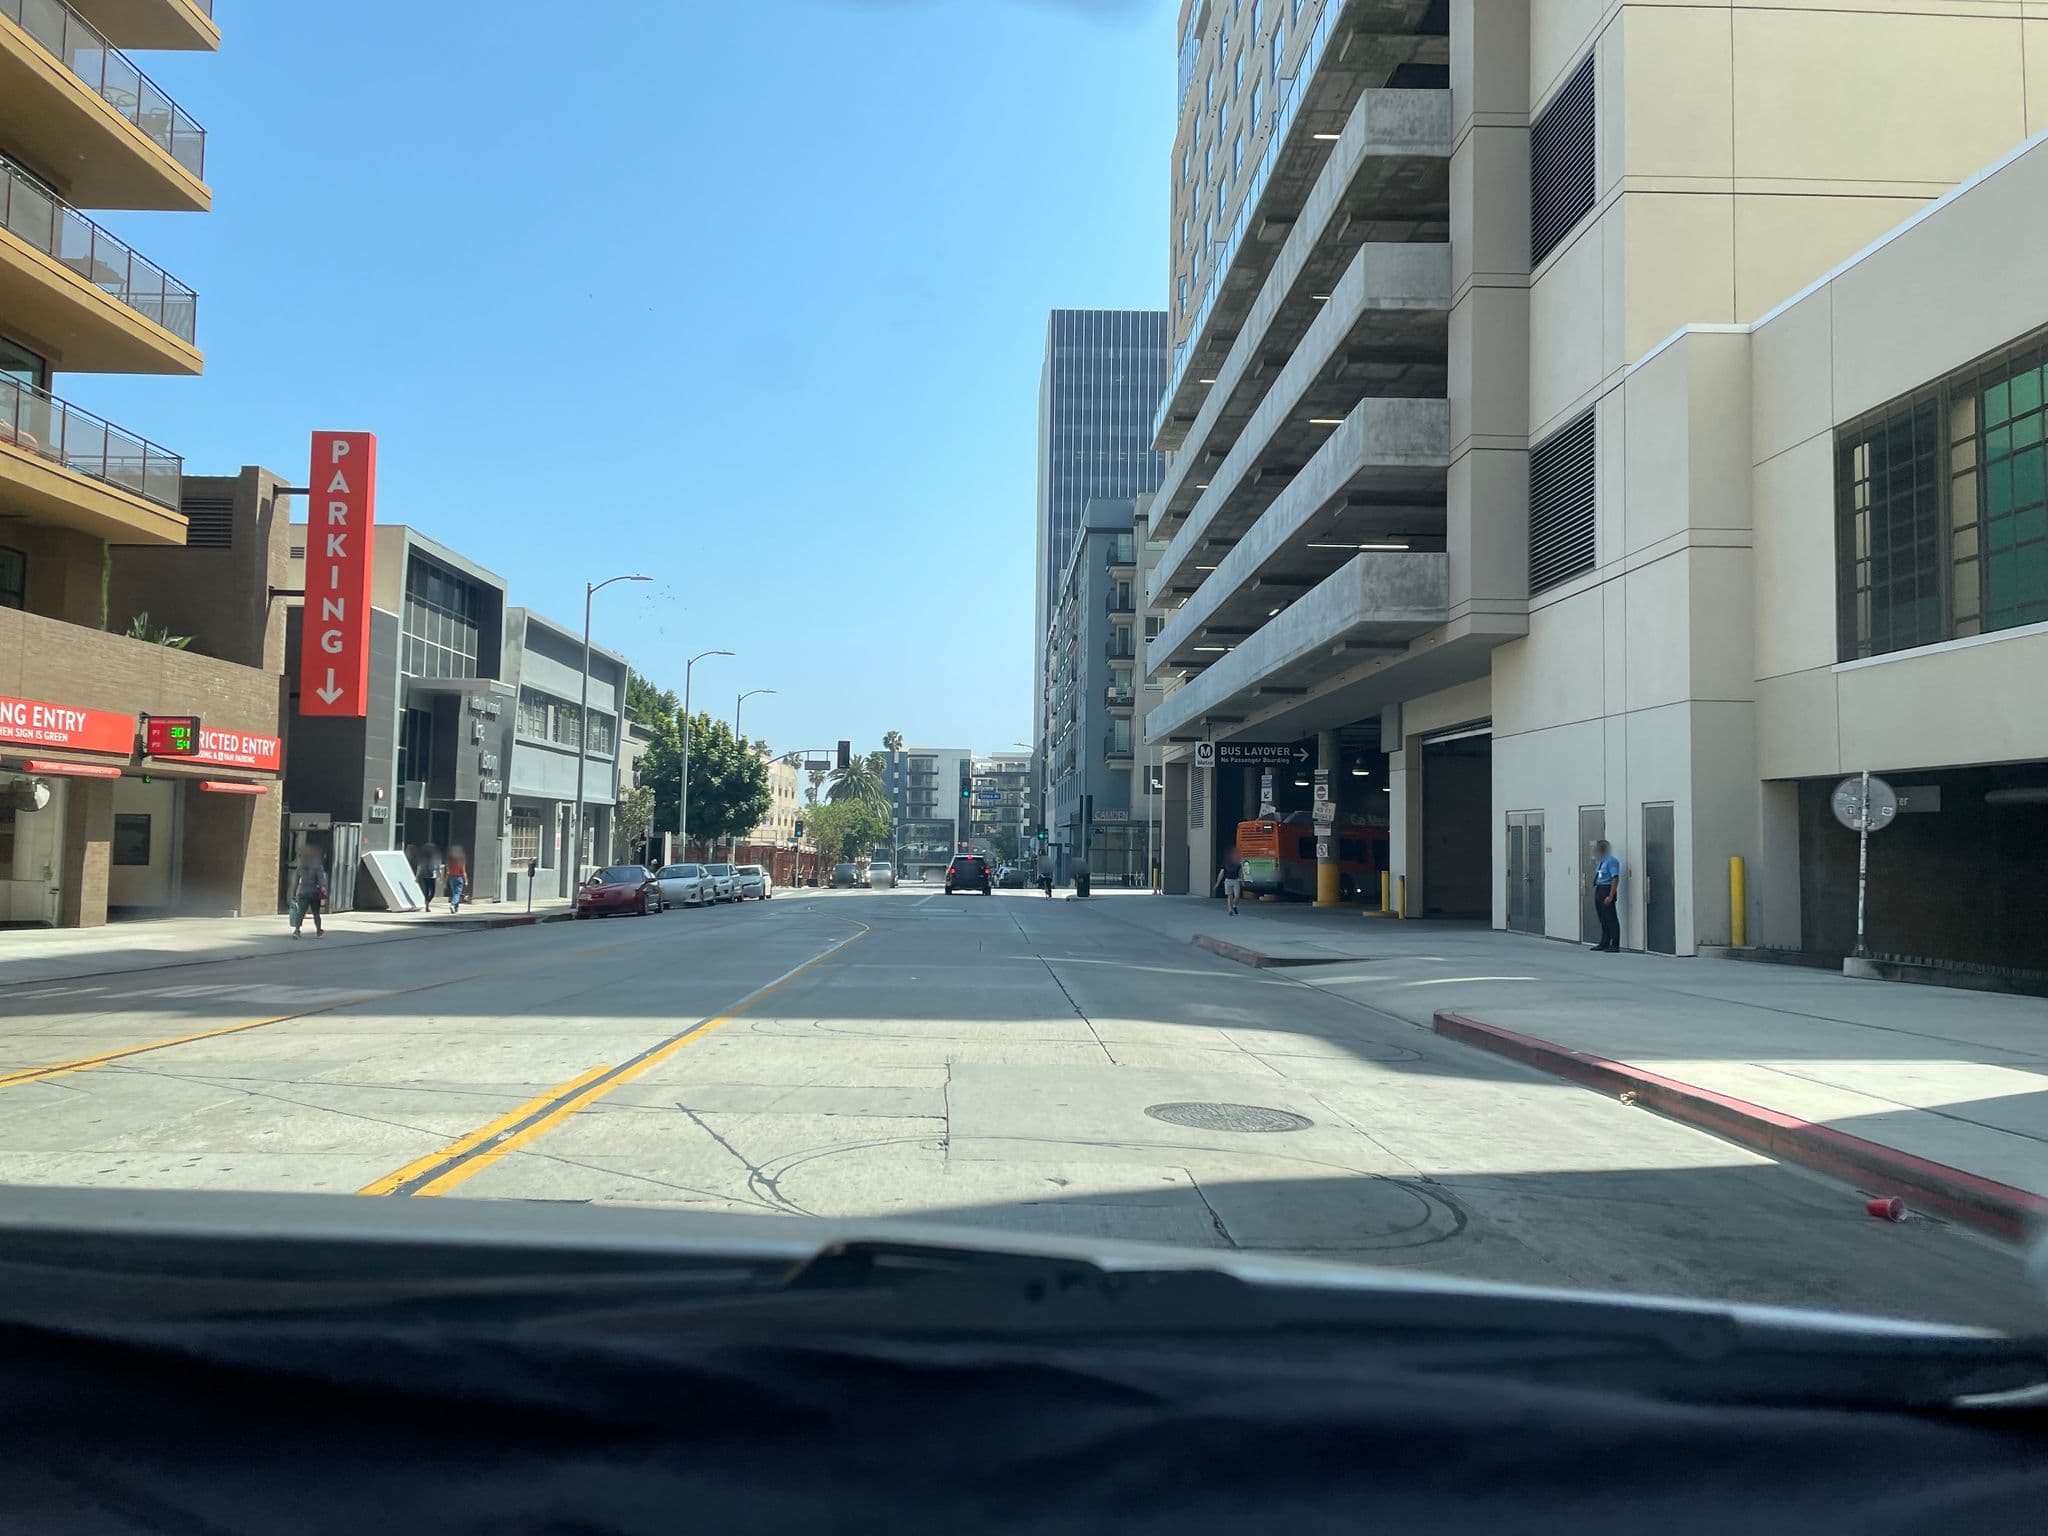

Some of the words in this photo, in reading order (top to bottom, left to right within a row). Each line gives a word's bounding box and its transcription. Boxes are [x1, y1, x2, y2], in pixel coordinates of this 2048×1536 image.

[321, 440, 350, 655] PARKING
[32, 706, 87, 732] ENTRY
[15, 728, 34, 739] SIGN
[36, 730, 43, 740] IS
[44, 731, 69, 743] GREEN
[170, 727, 191, 738] 301
[176, 740, 191, 750] 54
[242, 737, 277, 757] ENTRY
[1220, 747, 1241, 756] BUS
[1244, 747, 1290, 756] LAYOVER
[1230, 757, 1261, 765] Passenger
[1262, 757, 1290, 765] Boarding
[1094, 810, 1129, 820] CAMDEN
